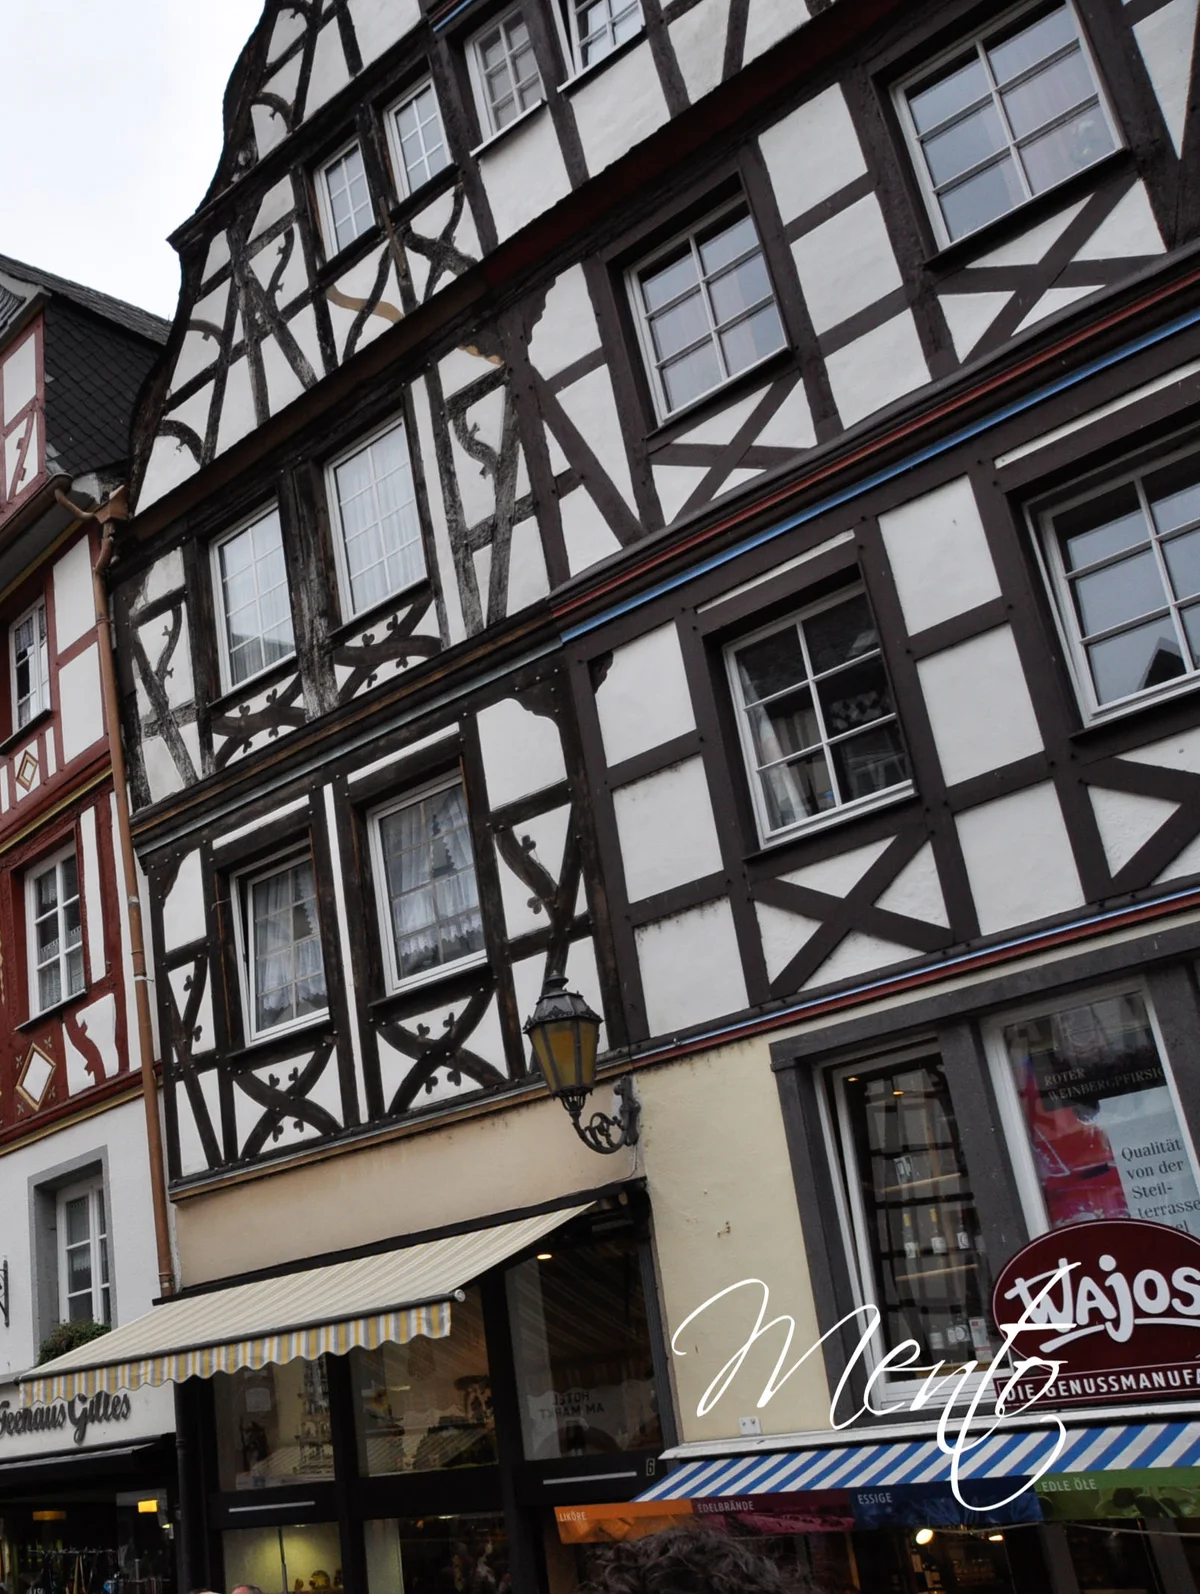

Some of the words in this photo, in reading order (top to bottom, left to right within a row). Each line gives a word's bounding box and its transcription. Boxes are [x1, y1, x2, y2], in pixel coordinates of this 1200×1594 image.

[1044, 1067, 1086, 1087] ROTER
[1121, 1139, 1183, 1162] Qualität
[1126, 1167, 1155, 1181] von
[1158, 1159, 1184, 1176] der
[1131, 1182, 1173, 1200] Steil-
[1006, 1383, 1036, 1402] DIE
[1041, 1480, 1070, 1492] EDLE
[1074, 1479, 1097, 1491] ÖLE
[697, 1500, 754, 1514] EDELBRÄNDE
[857, 1492, 893, 1505] ESSIGE
[559, 1512, 586, 1522] LIKÖRE
